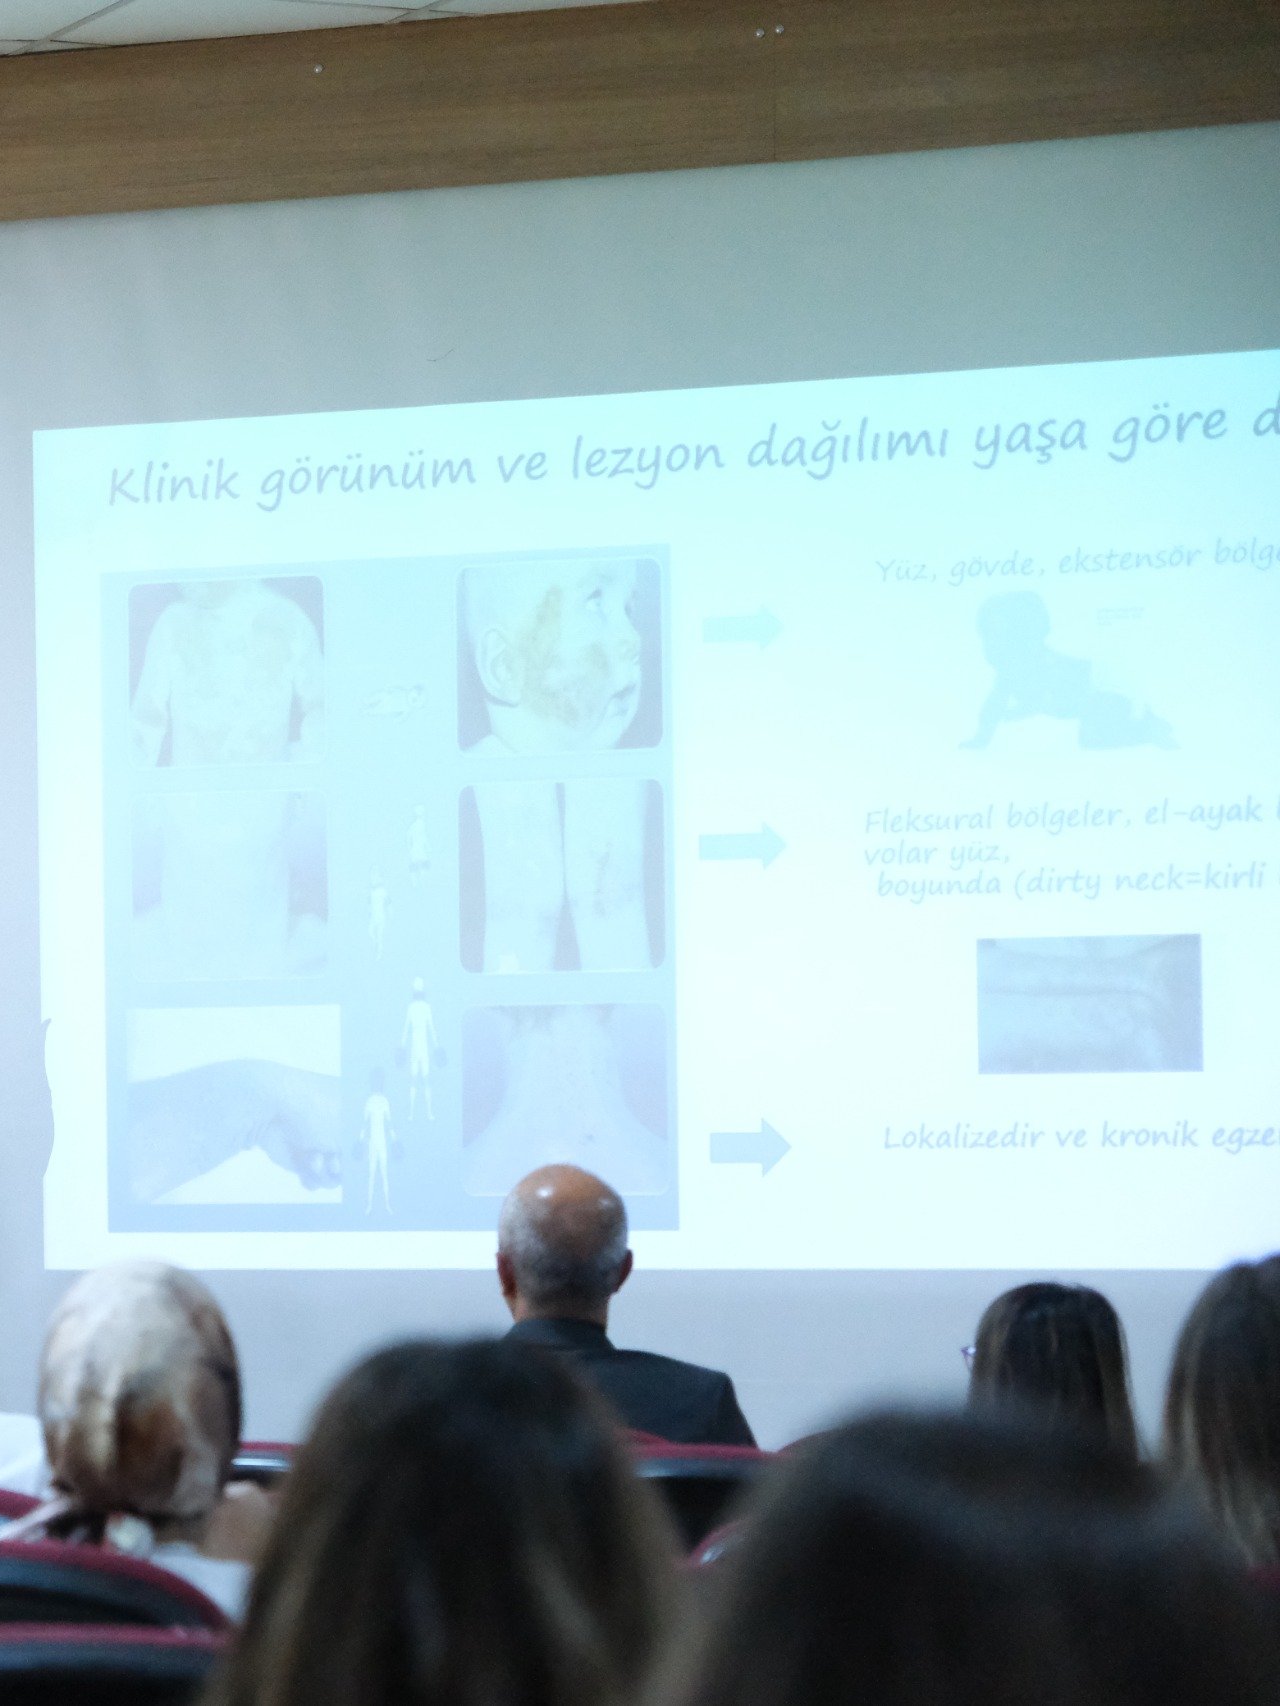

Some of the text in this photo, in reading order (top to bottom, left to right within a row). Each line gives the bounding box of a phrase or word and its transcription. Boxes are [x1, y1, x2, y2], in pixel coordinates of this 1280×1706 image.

[108, 458, 241, 507] Klinik
[257, 449, 477, 512] görünüm
[497, 447, 548, 482] ve
[572, 434, 725, 491] lezyon
[746, 416, 950, 481] dağılımı
[974, 416, 1089, 471] yaşa
[1111, 401, 1229, 463] göre
[874, 558, 938, 583] Yüz,
[949, 550, 1045, 587] gövde,
[1058, 544, 1202, 574] ekstensör
[864, 804, 995, 834] Fleksural
[1006, 801, 1132, 836] bölgeler,
[1144, 795, 1264, 832] el-ayak
[864, 839, 1011, 871] volar yüz,
[877, 871, 1001, 905] boyunda
[1013, 868, 1101, 900] (dirty
[1114, 860, 1268, 892] neck=kirli
[883, 1119, 1280, 1155] Lokalizedir ve kronik egze
